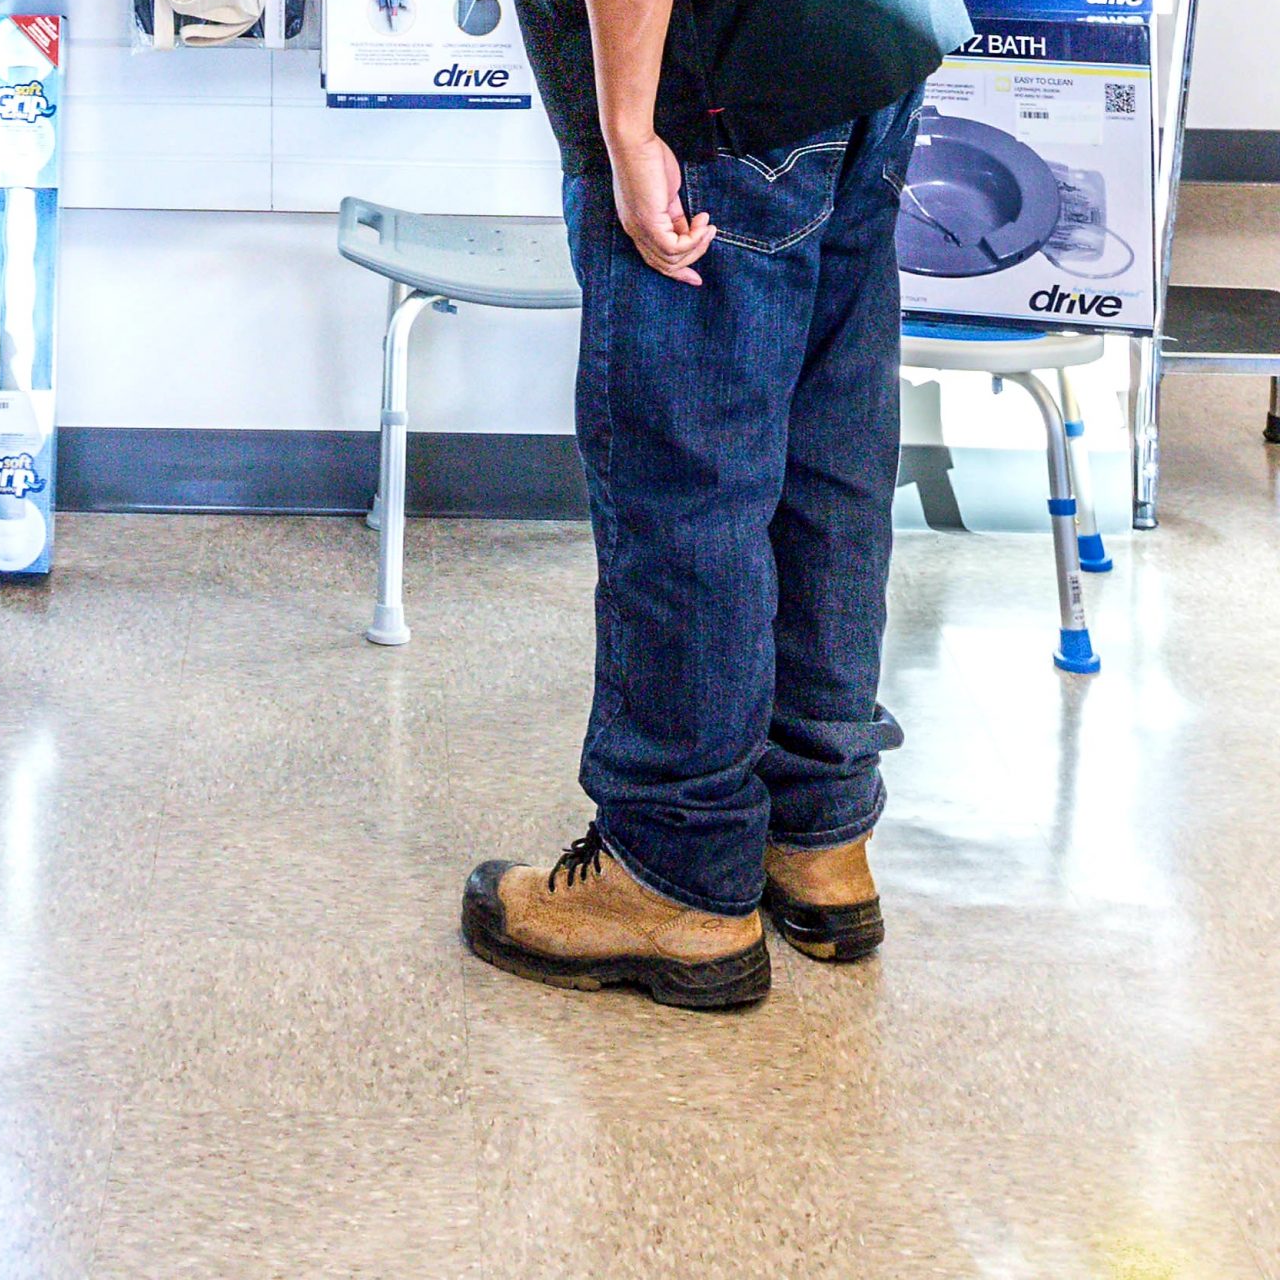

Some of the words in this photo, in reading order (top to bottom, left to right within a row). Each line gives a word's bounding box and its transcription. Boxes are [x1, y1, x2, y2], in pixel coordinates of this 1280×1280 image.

[988, 35, 1046, 56] BATH
[433, 63, 509, 87] drive
[1014, 76, 1033, 84] EASY
[1036, 77, 1046, 85] TO
[1048, 78, 1074, 86] CLEAN
[1029, 285, 1123, 317] drive
